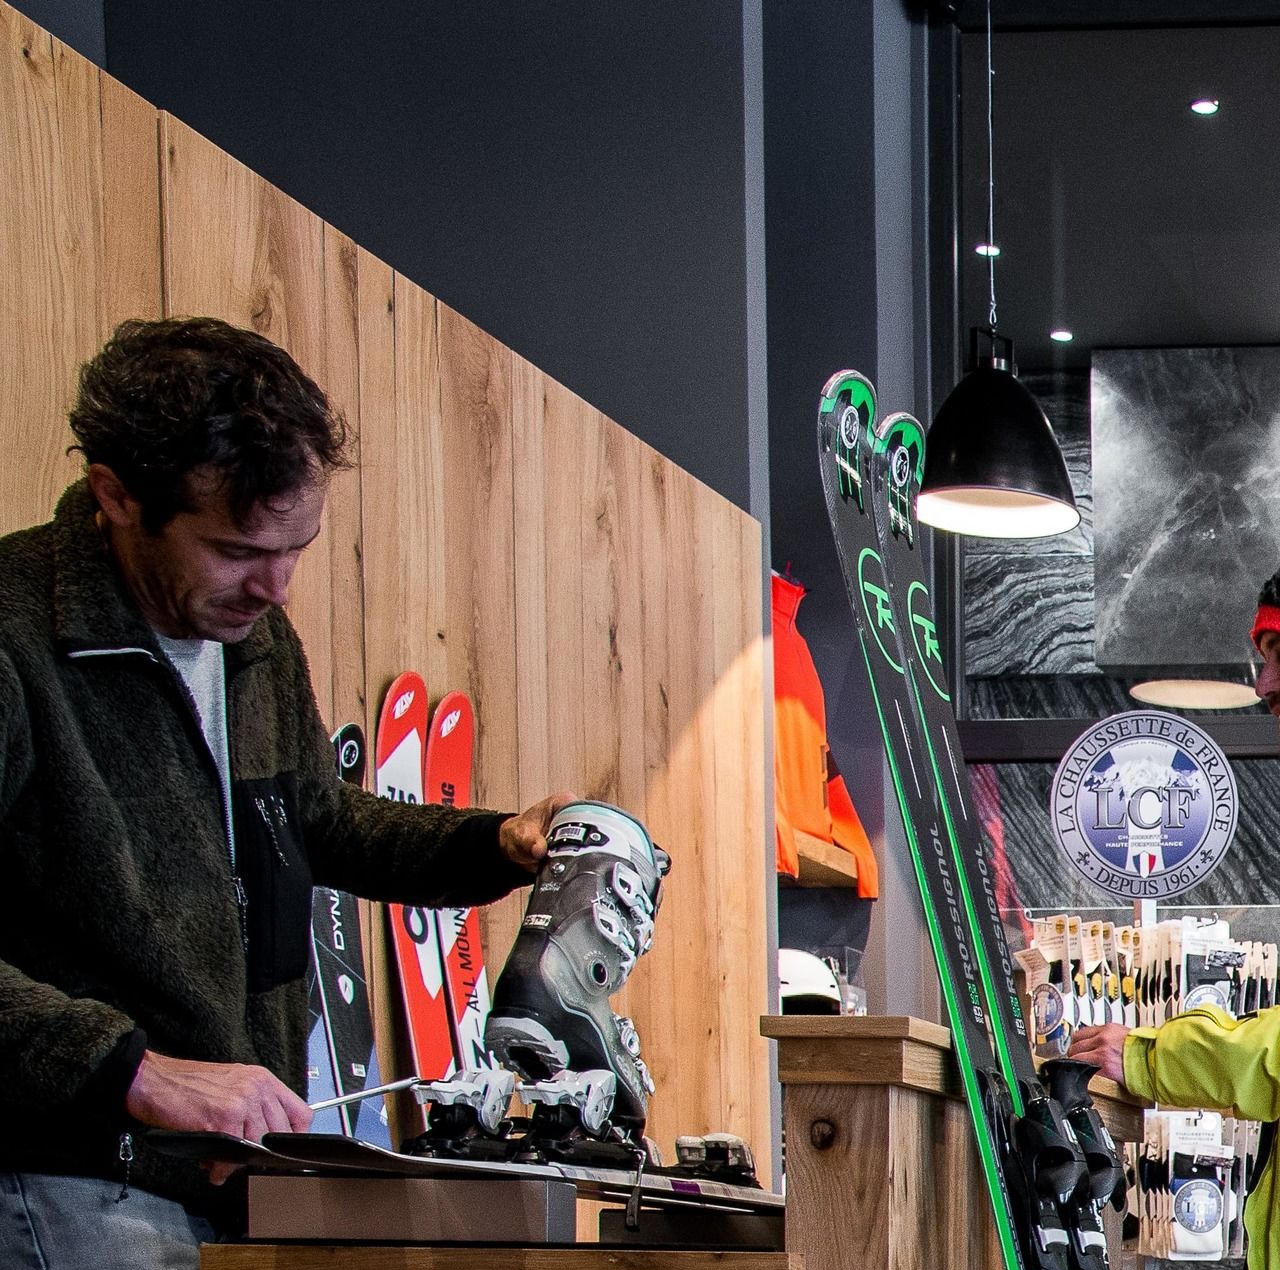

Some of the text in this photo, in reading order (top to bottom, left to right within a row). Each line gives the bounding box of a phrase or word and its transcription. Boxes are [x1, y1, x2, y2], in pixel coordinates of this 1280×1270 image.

[1058, 718, 1231, 834] LA CHAUSSETTE de FRANCE
[1092, 786, 1197, 830] LCF
[930, 822, 974, 981] ROSSIGNOL
[976, 842, 1016, 992] ROSSIGNOL
[1094, 865, 1199, 896] DEPUIS 1961
[455, 907, 473, 971] MOUN
